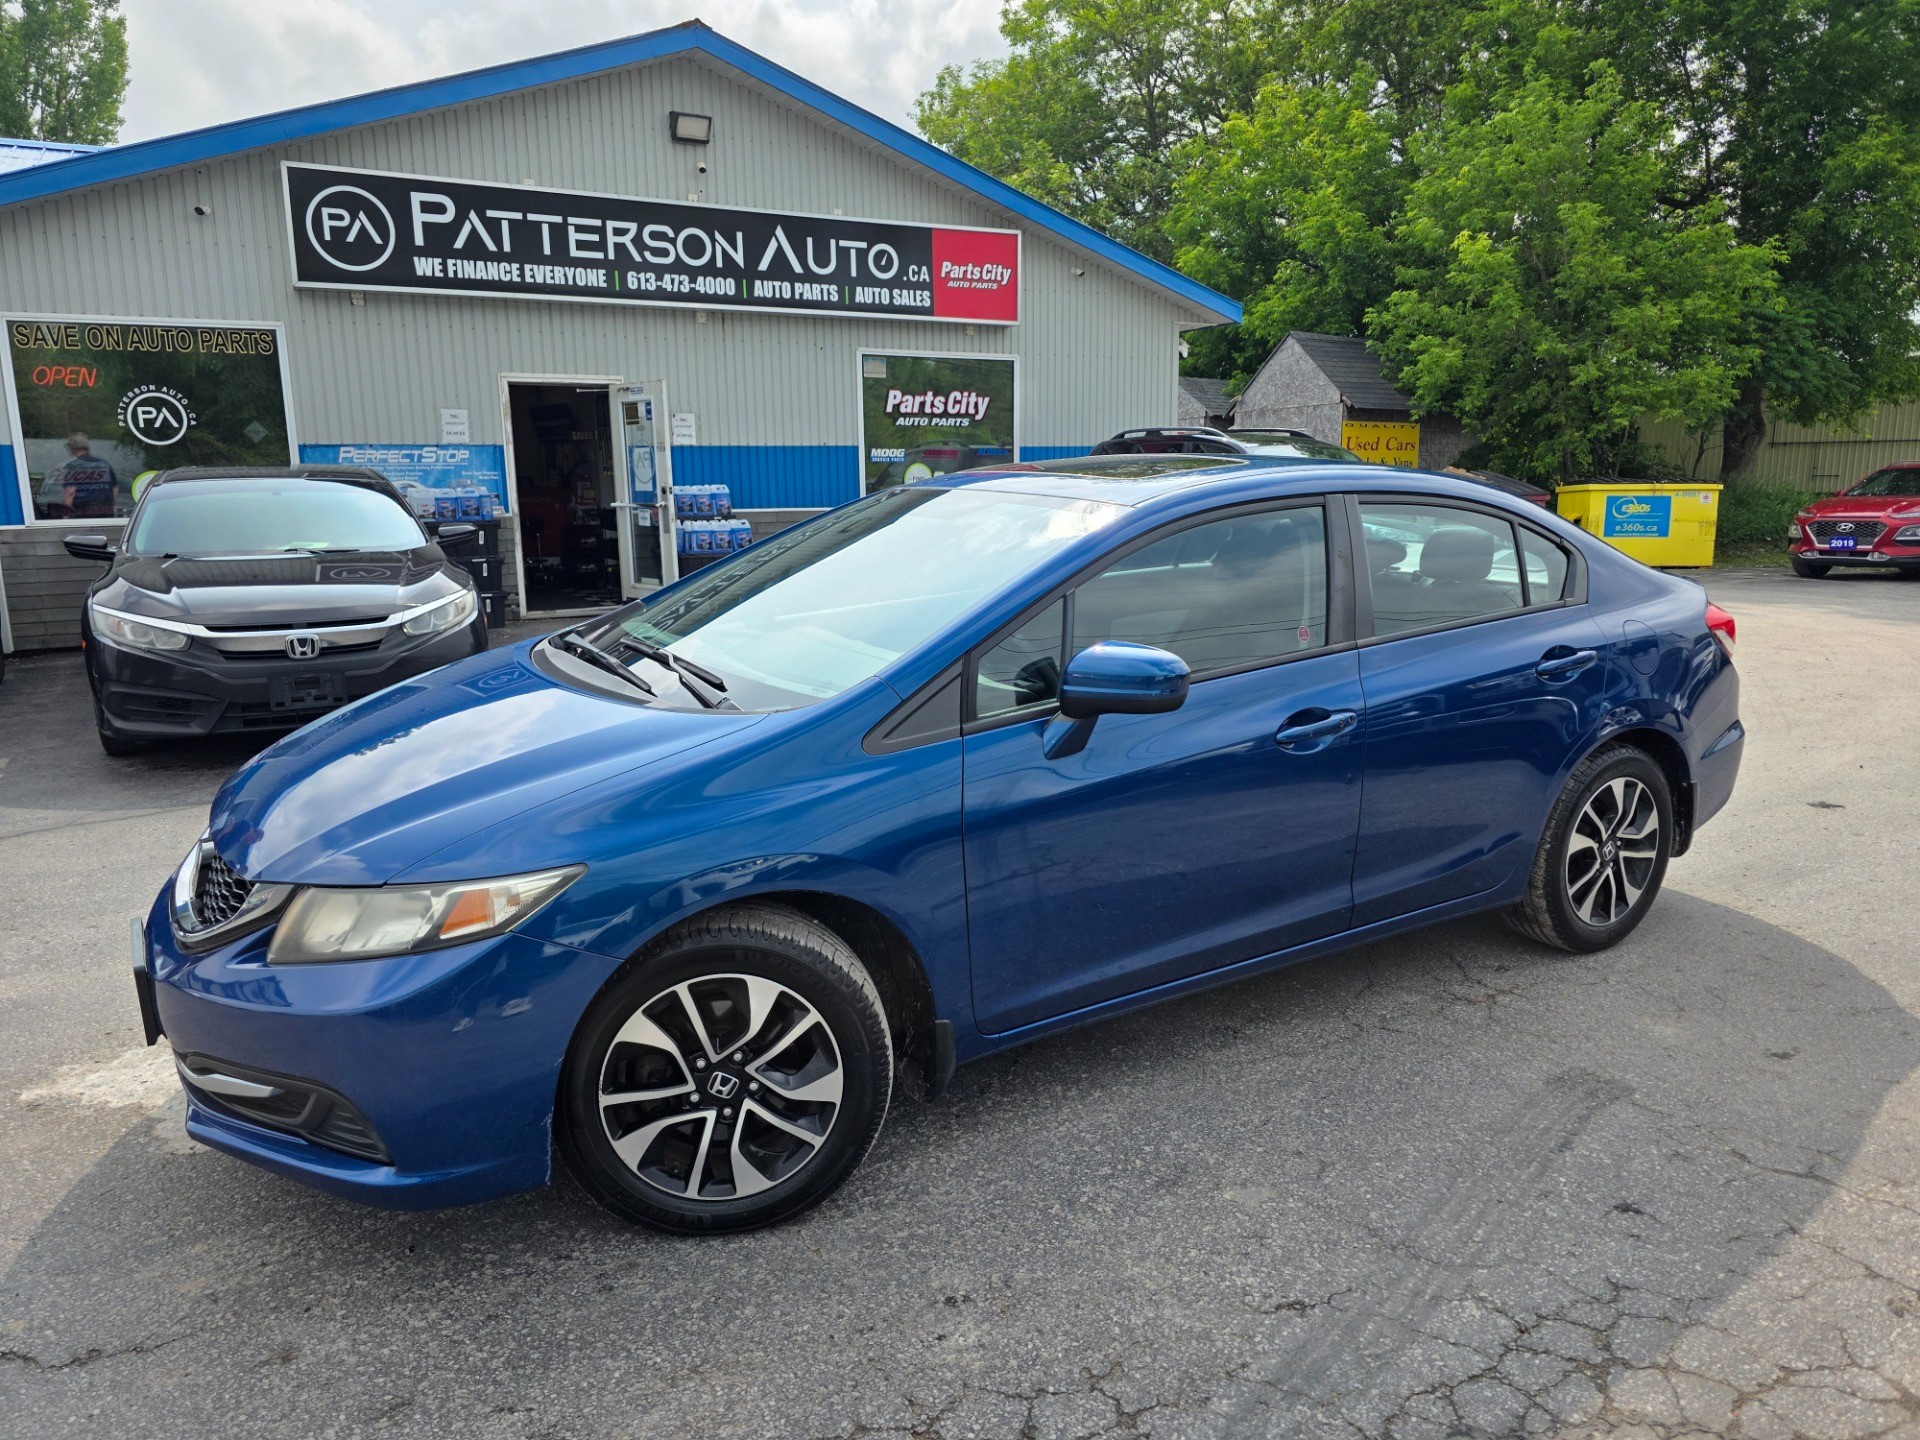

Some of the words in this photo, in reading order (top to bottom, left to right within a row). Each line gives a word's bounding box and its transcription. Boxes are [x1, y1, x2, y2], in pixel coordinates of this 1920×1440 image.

[409, 191, 745, 270] PATTERSON
[413, 256, 444, 278] WE
[447, 258, 522, 283] FINANCE
[524, 263, 607, 288] EVERYONE
[626, 270, 736, 297] 613-473-4000
[753, 279, 792, 300] AUTO
[794, 282, 839, 302] PARTS
[854, 286, 890, 306] AUTO
[892, 288, 932, 308] SALES
[947, 280, 970, 288] AUTO
[971, 281, 998, 290] PARTS
[13, 323, 82, 350] SAVE
[84, 325, 123, 351] ON
[127, 327, 194, 352] AUTO
[197, 329, 274, 355] PARTS
[32, 365, 97, 388] OPEN
[117, 384, 156, 427] PATTERSON
[895, 416, 929, 427] AUTO
[930, 417, 970, 427] PARTS
[1346, 436, 1381, 451] Used
[1385, 436, 1416, 451] Cars
[871, 448, 905, 457] MOOG
[1393, 457, 1413, 468] Vans
[54, 469, 107, 482] LUCAS
[1615, 523, 1658, 532] e360s.ca
[1830, 539, 1854, 547] 2019
